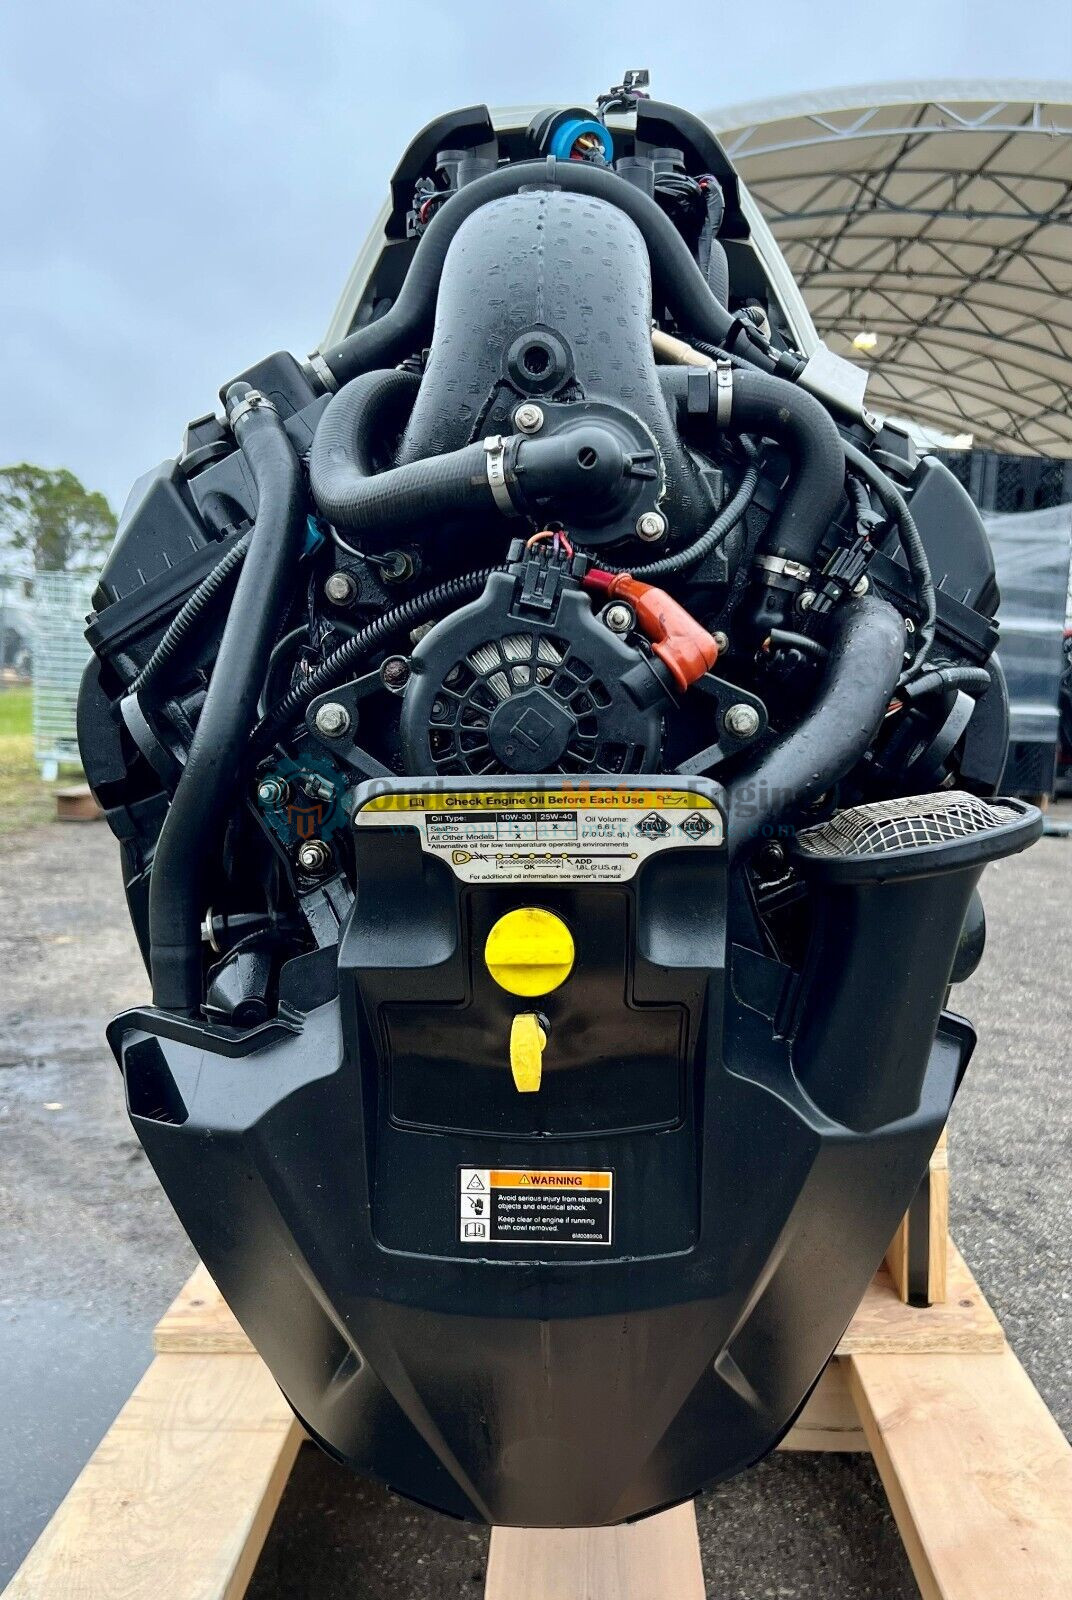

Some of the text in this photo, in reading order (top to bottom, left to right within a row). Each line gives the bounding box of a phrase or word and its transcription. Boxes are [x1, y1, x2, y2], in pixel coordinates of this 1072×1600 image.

[445, 795, 645, 807] Check Engine Oil Before Each Use
[431, 813, 573, 824] Oil Type: 10W-30 25W-40
[585, 815, 629, 823] Oil Volume:
[548, 841, 581, 849] operating
[531, 1176, 583, 1186] WARNING
[543, 1195, 561, 1203] injury
[578, 1196, 603, 1205] rotating
[497, 1203, 522, 1212] objects
[536, 1203, 566, 1211] electrical
[497, 1215, 516, 1223] Keep
[541, 1216, 564, 1225] engine
[570, 1217, 596, 1226] running
[528, 1224, 560, 1232] removed.
